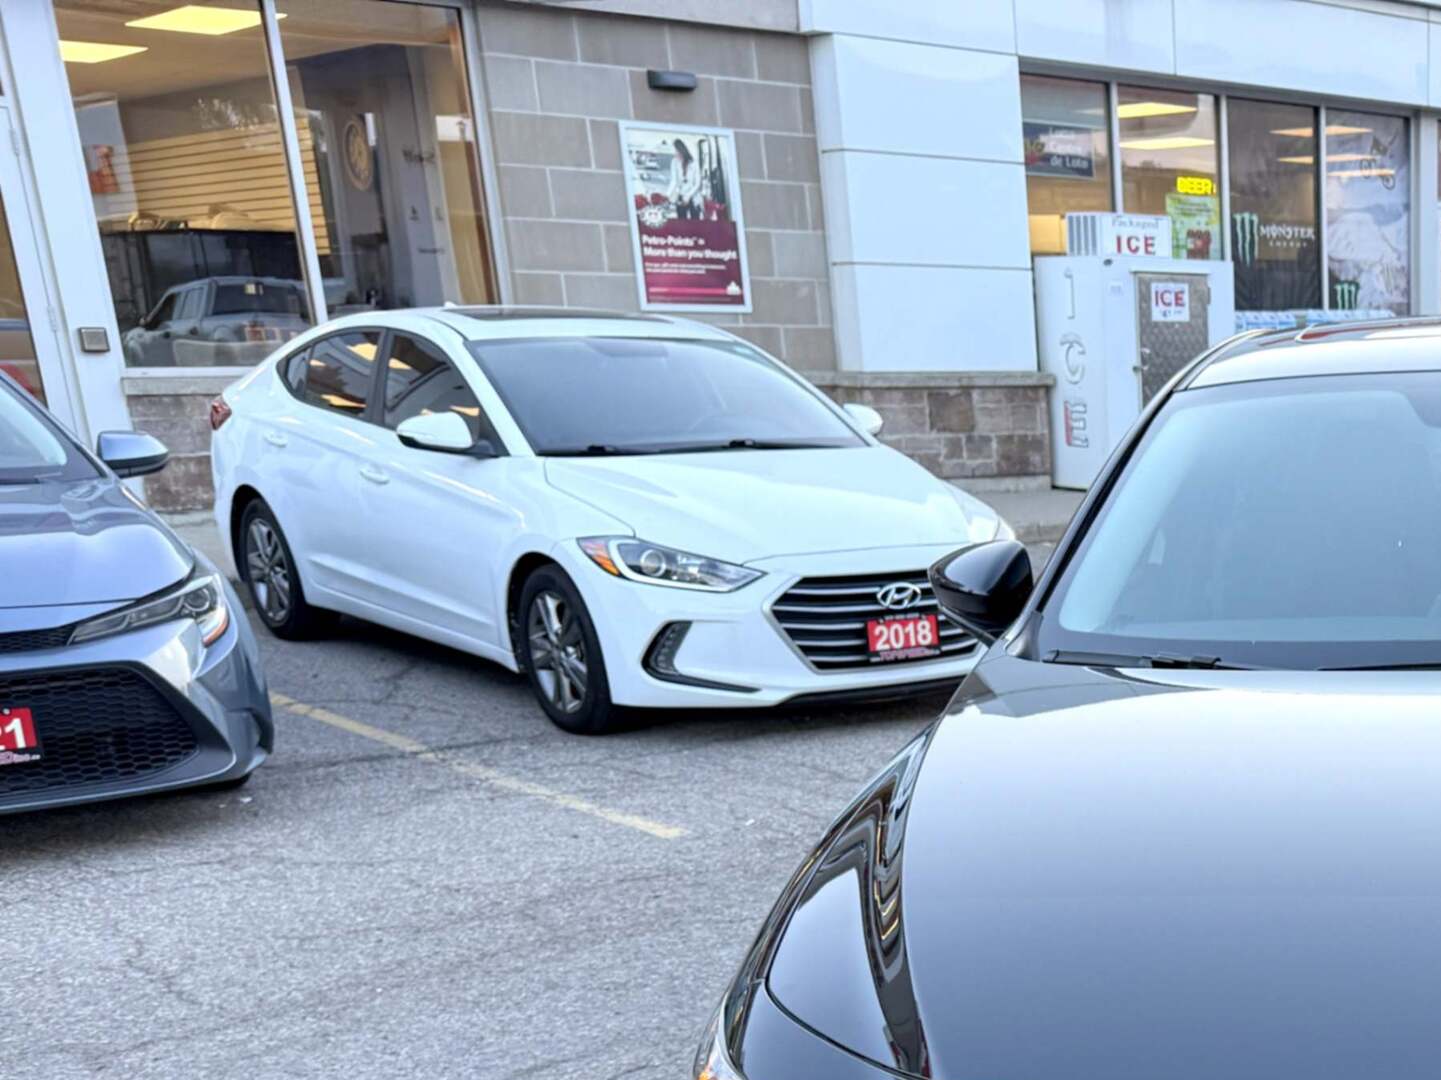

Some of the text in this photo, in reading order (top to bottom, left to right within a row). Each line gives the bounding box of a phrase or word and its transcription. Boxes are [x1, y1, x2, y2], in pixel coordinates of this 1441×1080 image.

[1116, 234, 1157, 256] ICE
[1154, 290, 1186, 308] ICE
[874, 620, 933, 651] 2018
[0, 717, 27, 751] 1
